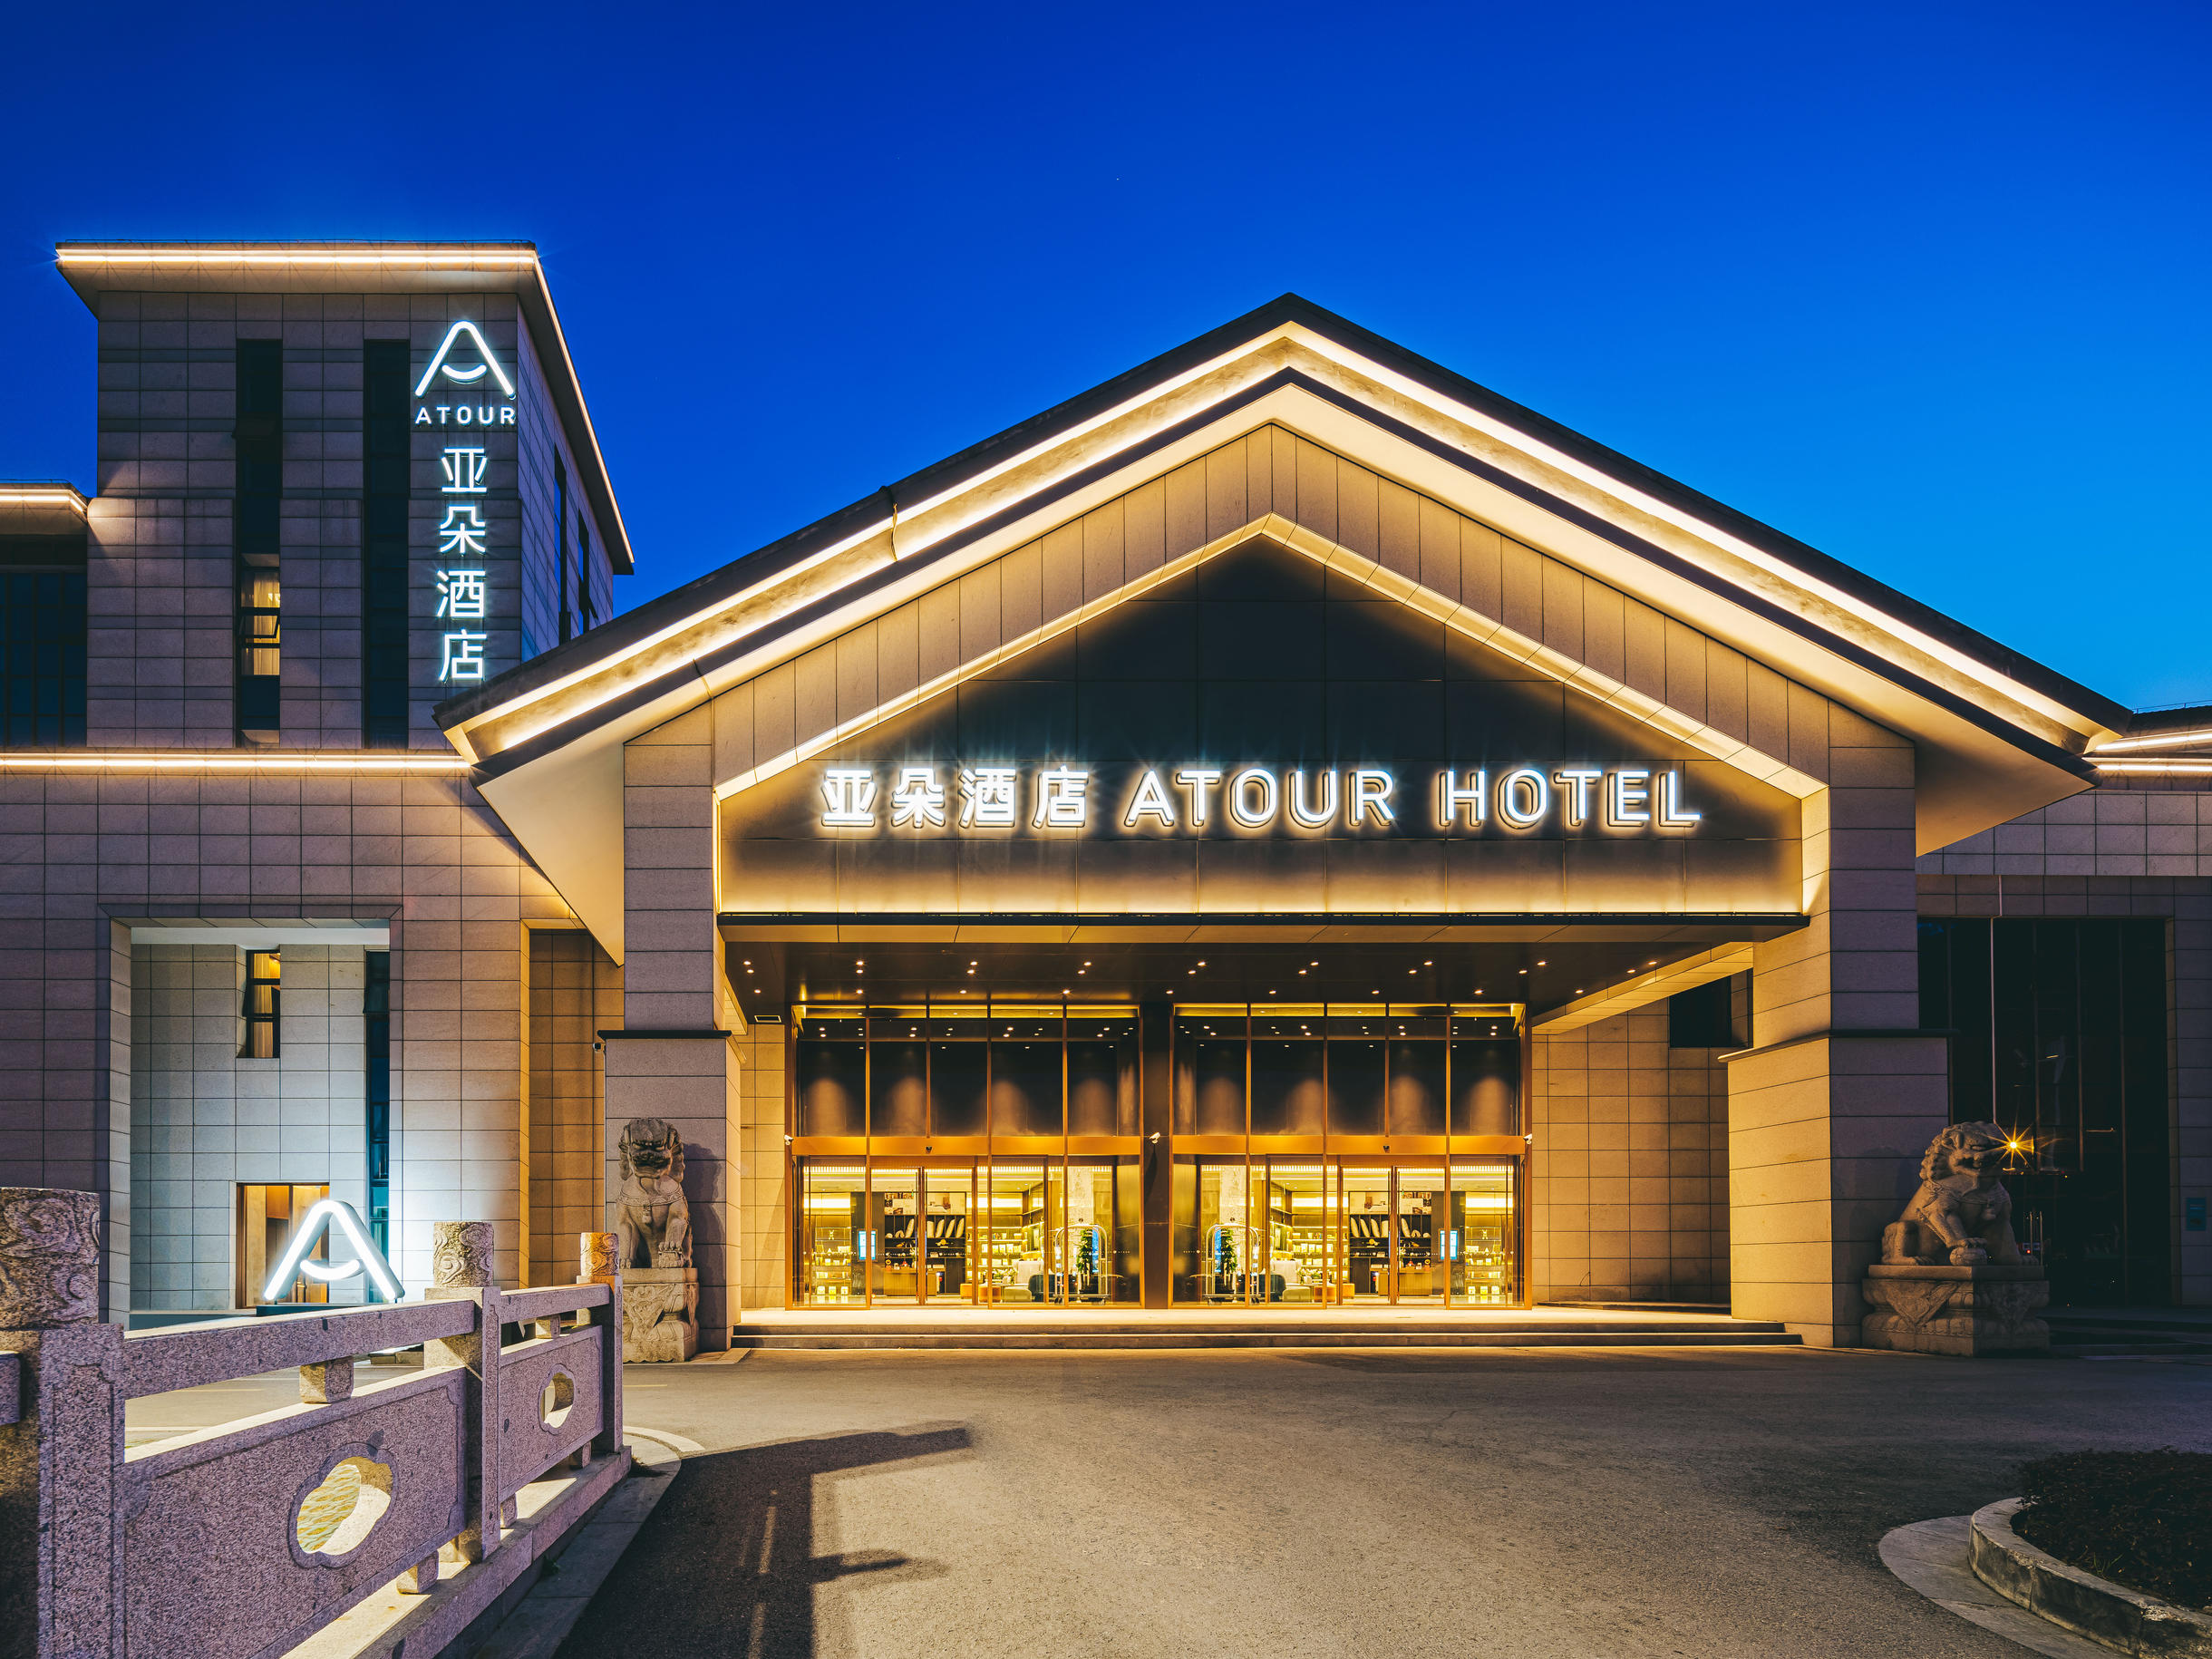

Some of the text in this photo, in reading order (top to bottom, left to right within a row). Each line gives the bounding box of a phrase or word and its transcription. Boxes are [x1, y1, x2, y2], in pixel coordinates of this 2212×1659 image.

[414, 406, 516, 425] ATOUR
[436, 448, 488, 682] 亚朵酒店
[821, 765, 1702, 828] 亚朵酒店 ATOUR HOTEL
